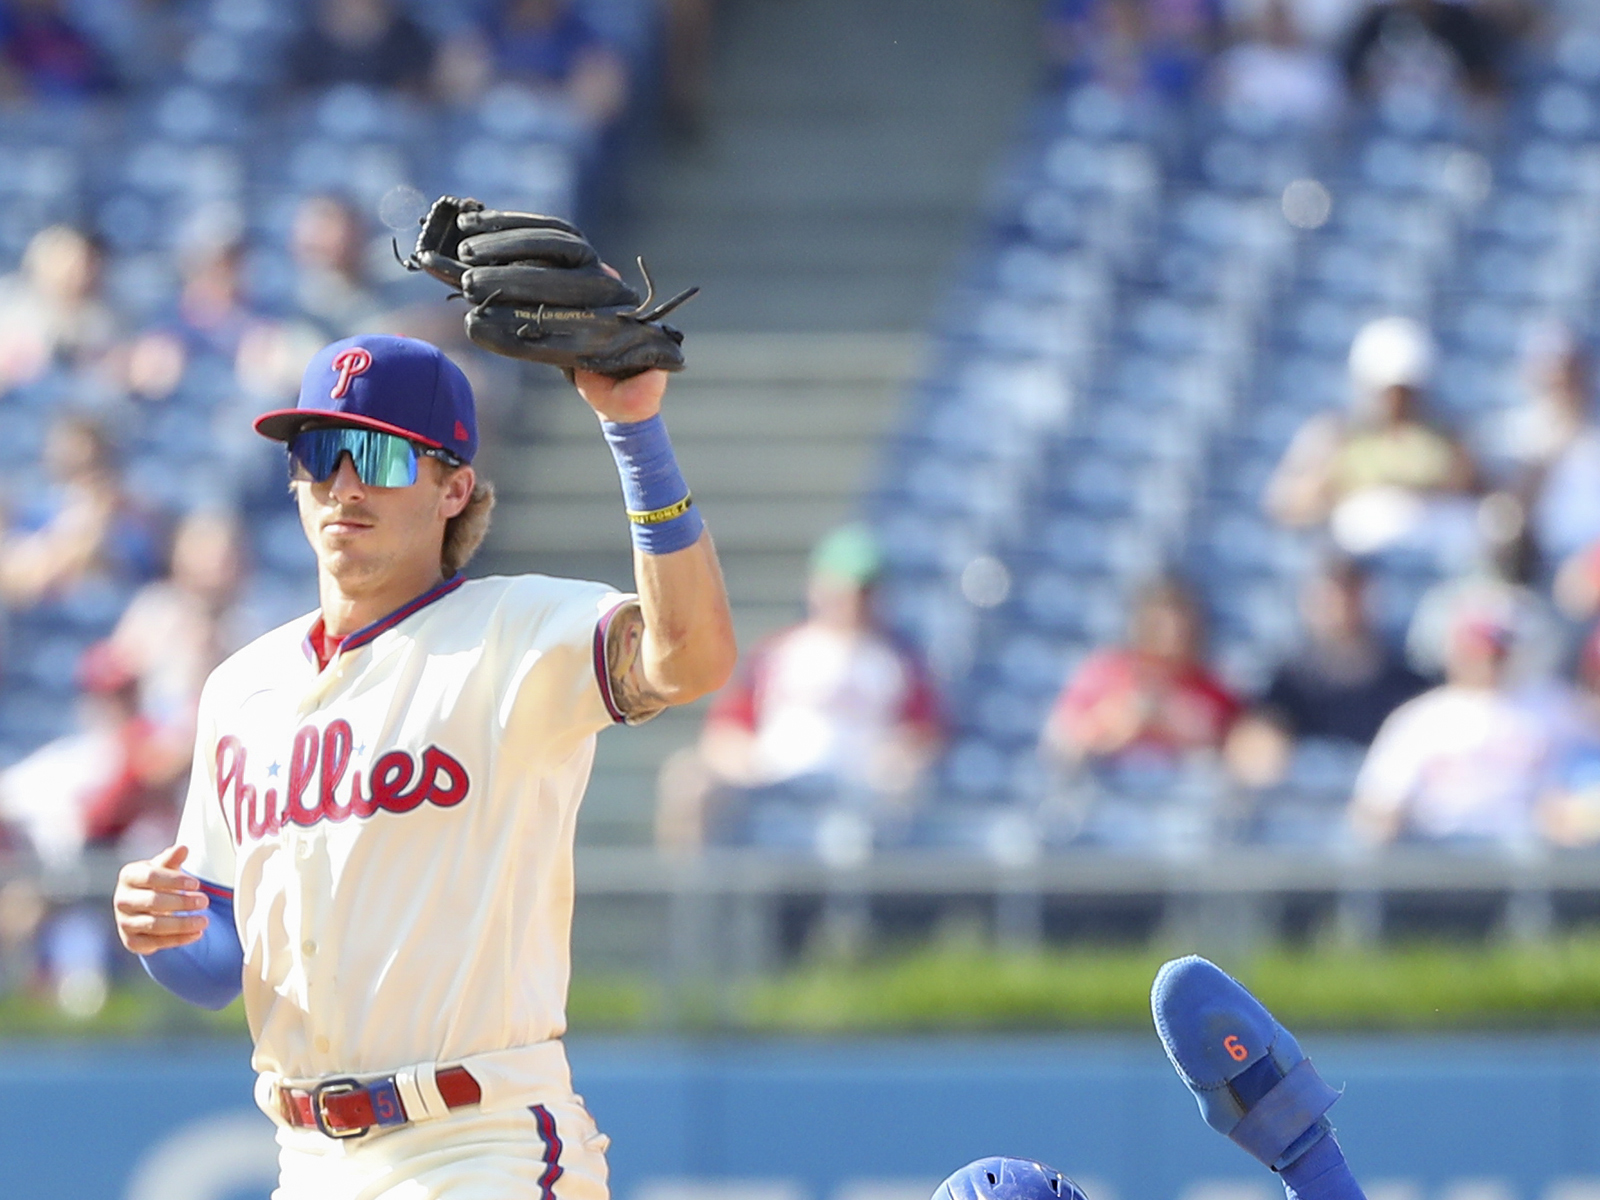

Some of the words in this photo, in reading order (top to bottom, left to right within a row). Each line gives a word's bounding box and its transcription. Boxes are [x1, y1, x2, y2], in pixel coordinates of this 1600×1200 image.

[330, 347, 372, 399] P
[216, 719, 470, 850] Phillies
[1223, 1034, 1249, 1062] 6
[376, 1091, 395, 1118] 5
